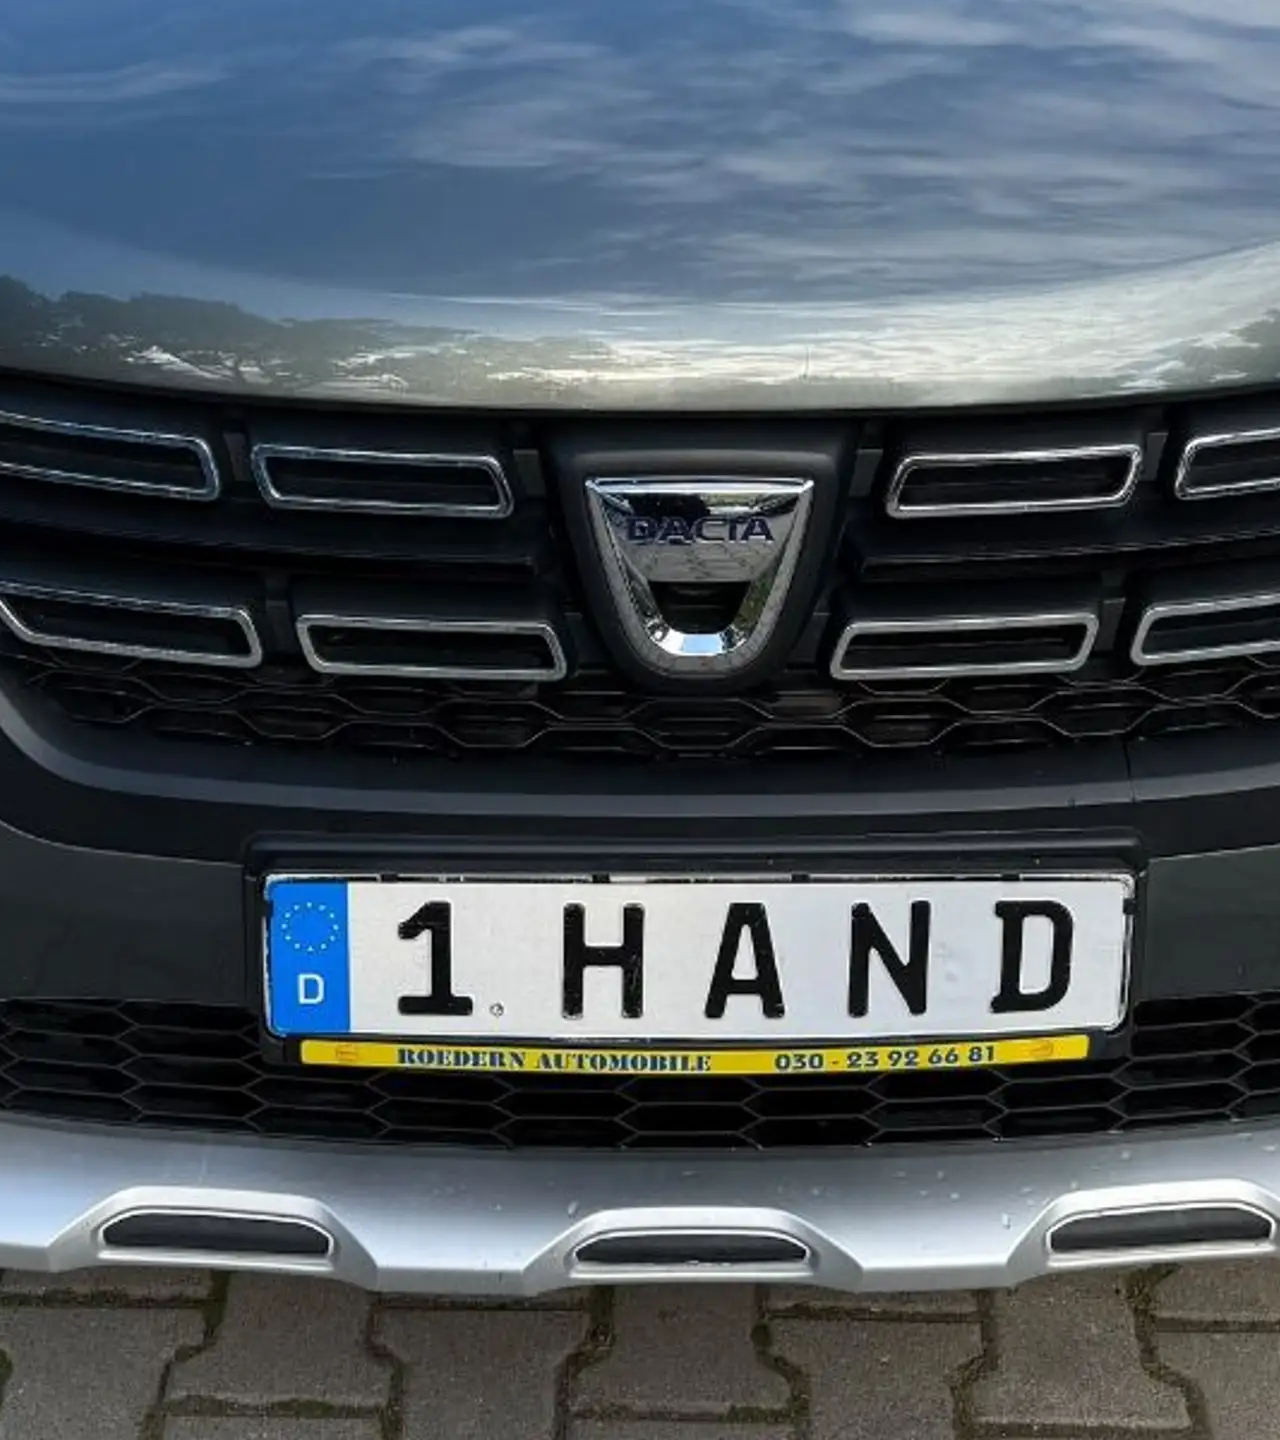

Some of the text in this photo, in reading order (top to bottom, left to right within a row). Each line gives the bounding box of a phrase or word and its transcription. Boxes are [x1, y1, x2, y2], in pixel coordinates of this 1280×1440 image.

[625, 515, 774, 545] DACIA
[561, 899, 1075, 1020] HAND
[297, 973, 325, 1006] D
[396, 1047, 526, 1068] ROEDERN
[536, 1052, 712, 1072] AUTOMOBILE
[774, 1053, 824, 1070] 030
[846, 1051, 880, 1069] 23
[886, 1048, 920, 1067] 92
[927, 1047, 960, 1065] 66
[966, 1044, 996, 1063] 81
